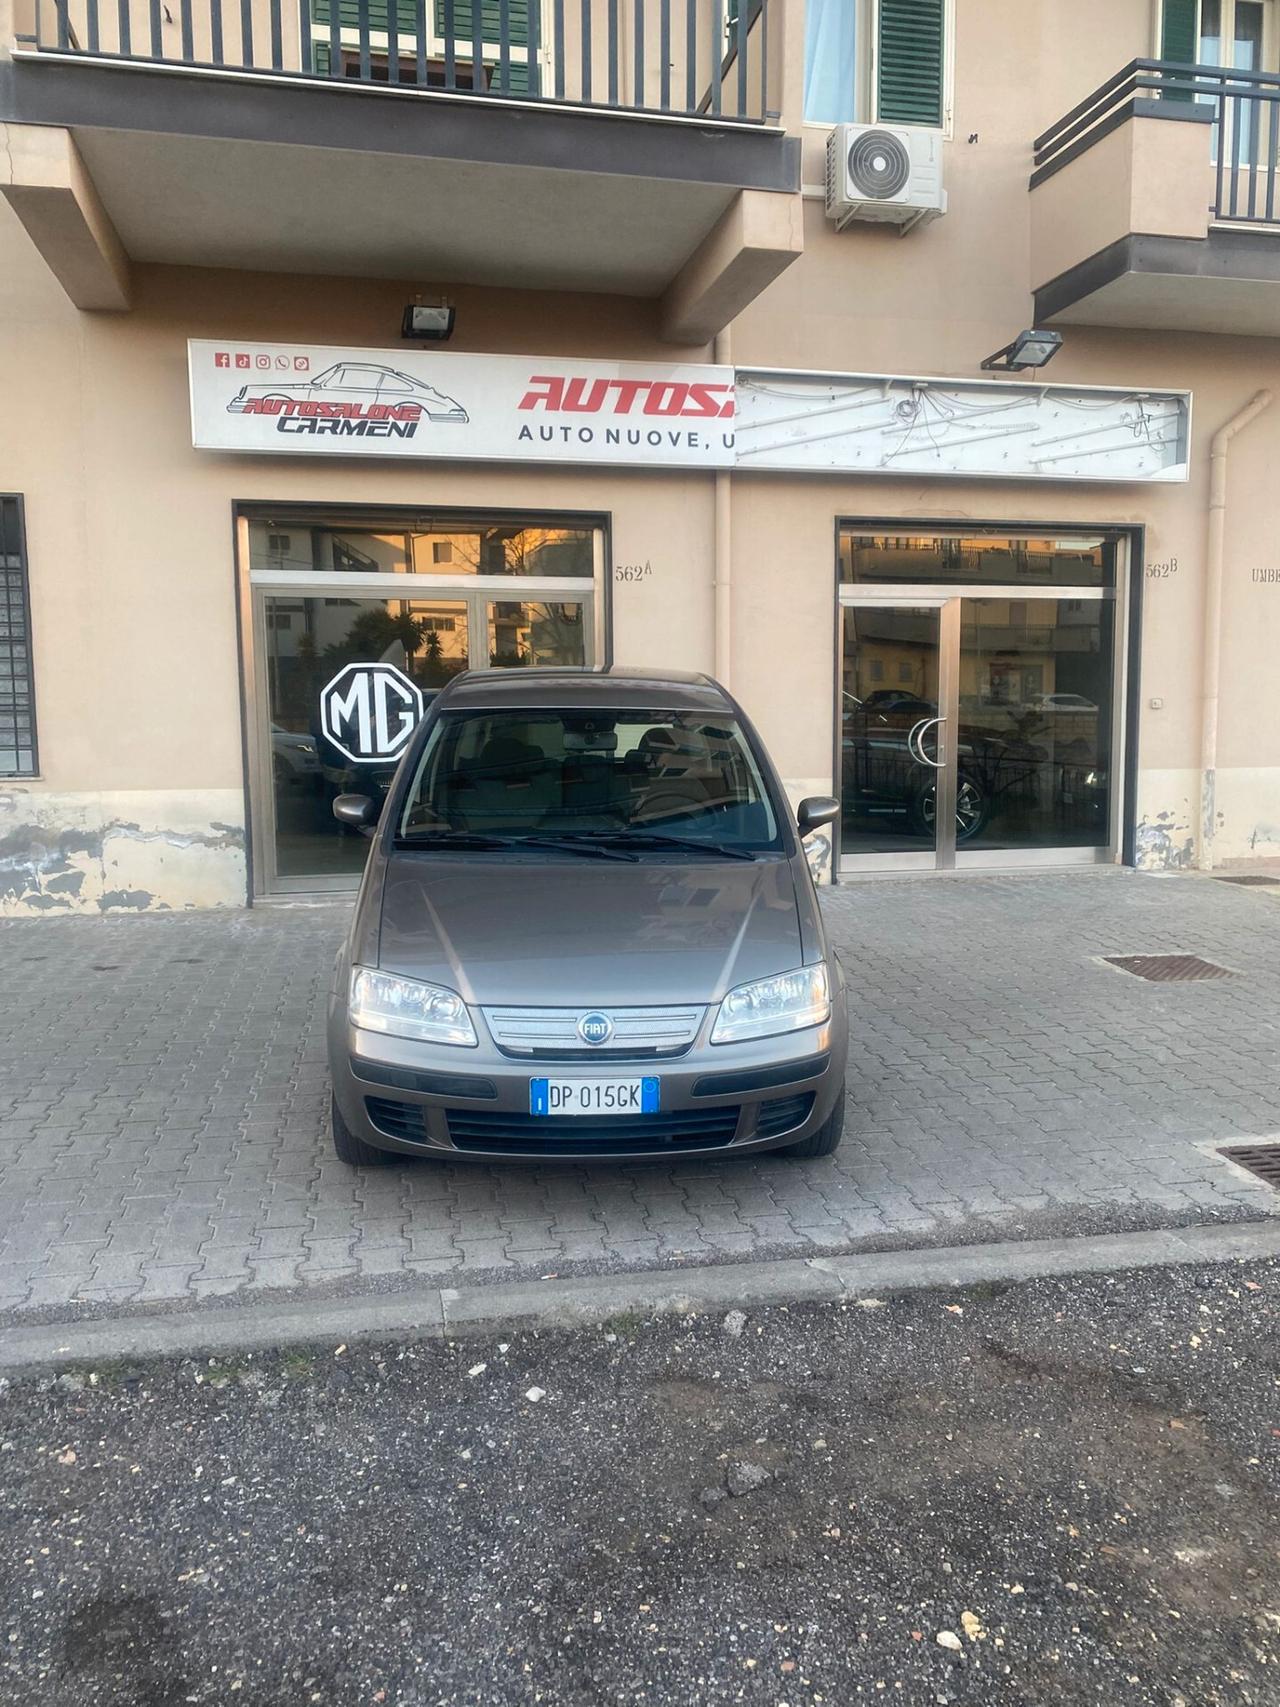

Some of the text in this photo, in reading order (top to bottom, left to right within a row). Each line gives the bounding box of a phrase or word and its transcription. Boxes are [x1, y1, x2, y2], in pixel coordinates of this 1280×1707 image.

[242, 397, 421, 422] AUTOSALONE
[276, 415, 418, 438] CARMENI
[518, 424, 594, 443] AUTO
[606, 428, 710, 450] NUOVE,
[330, 672, 414, 754] MG
[584, 1023, 606, 1034] FIAT
